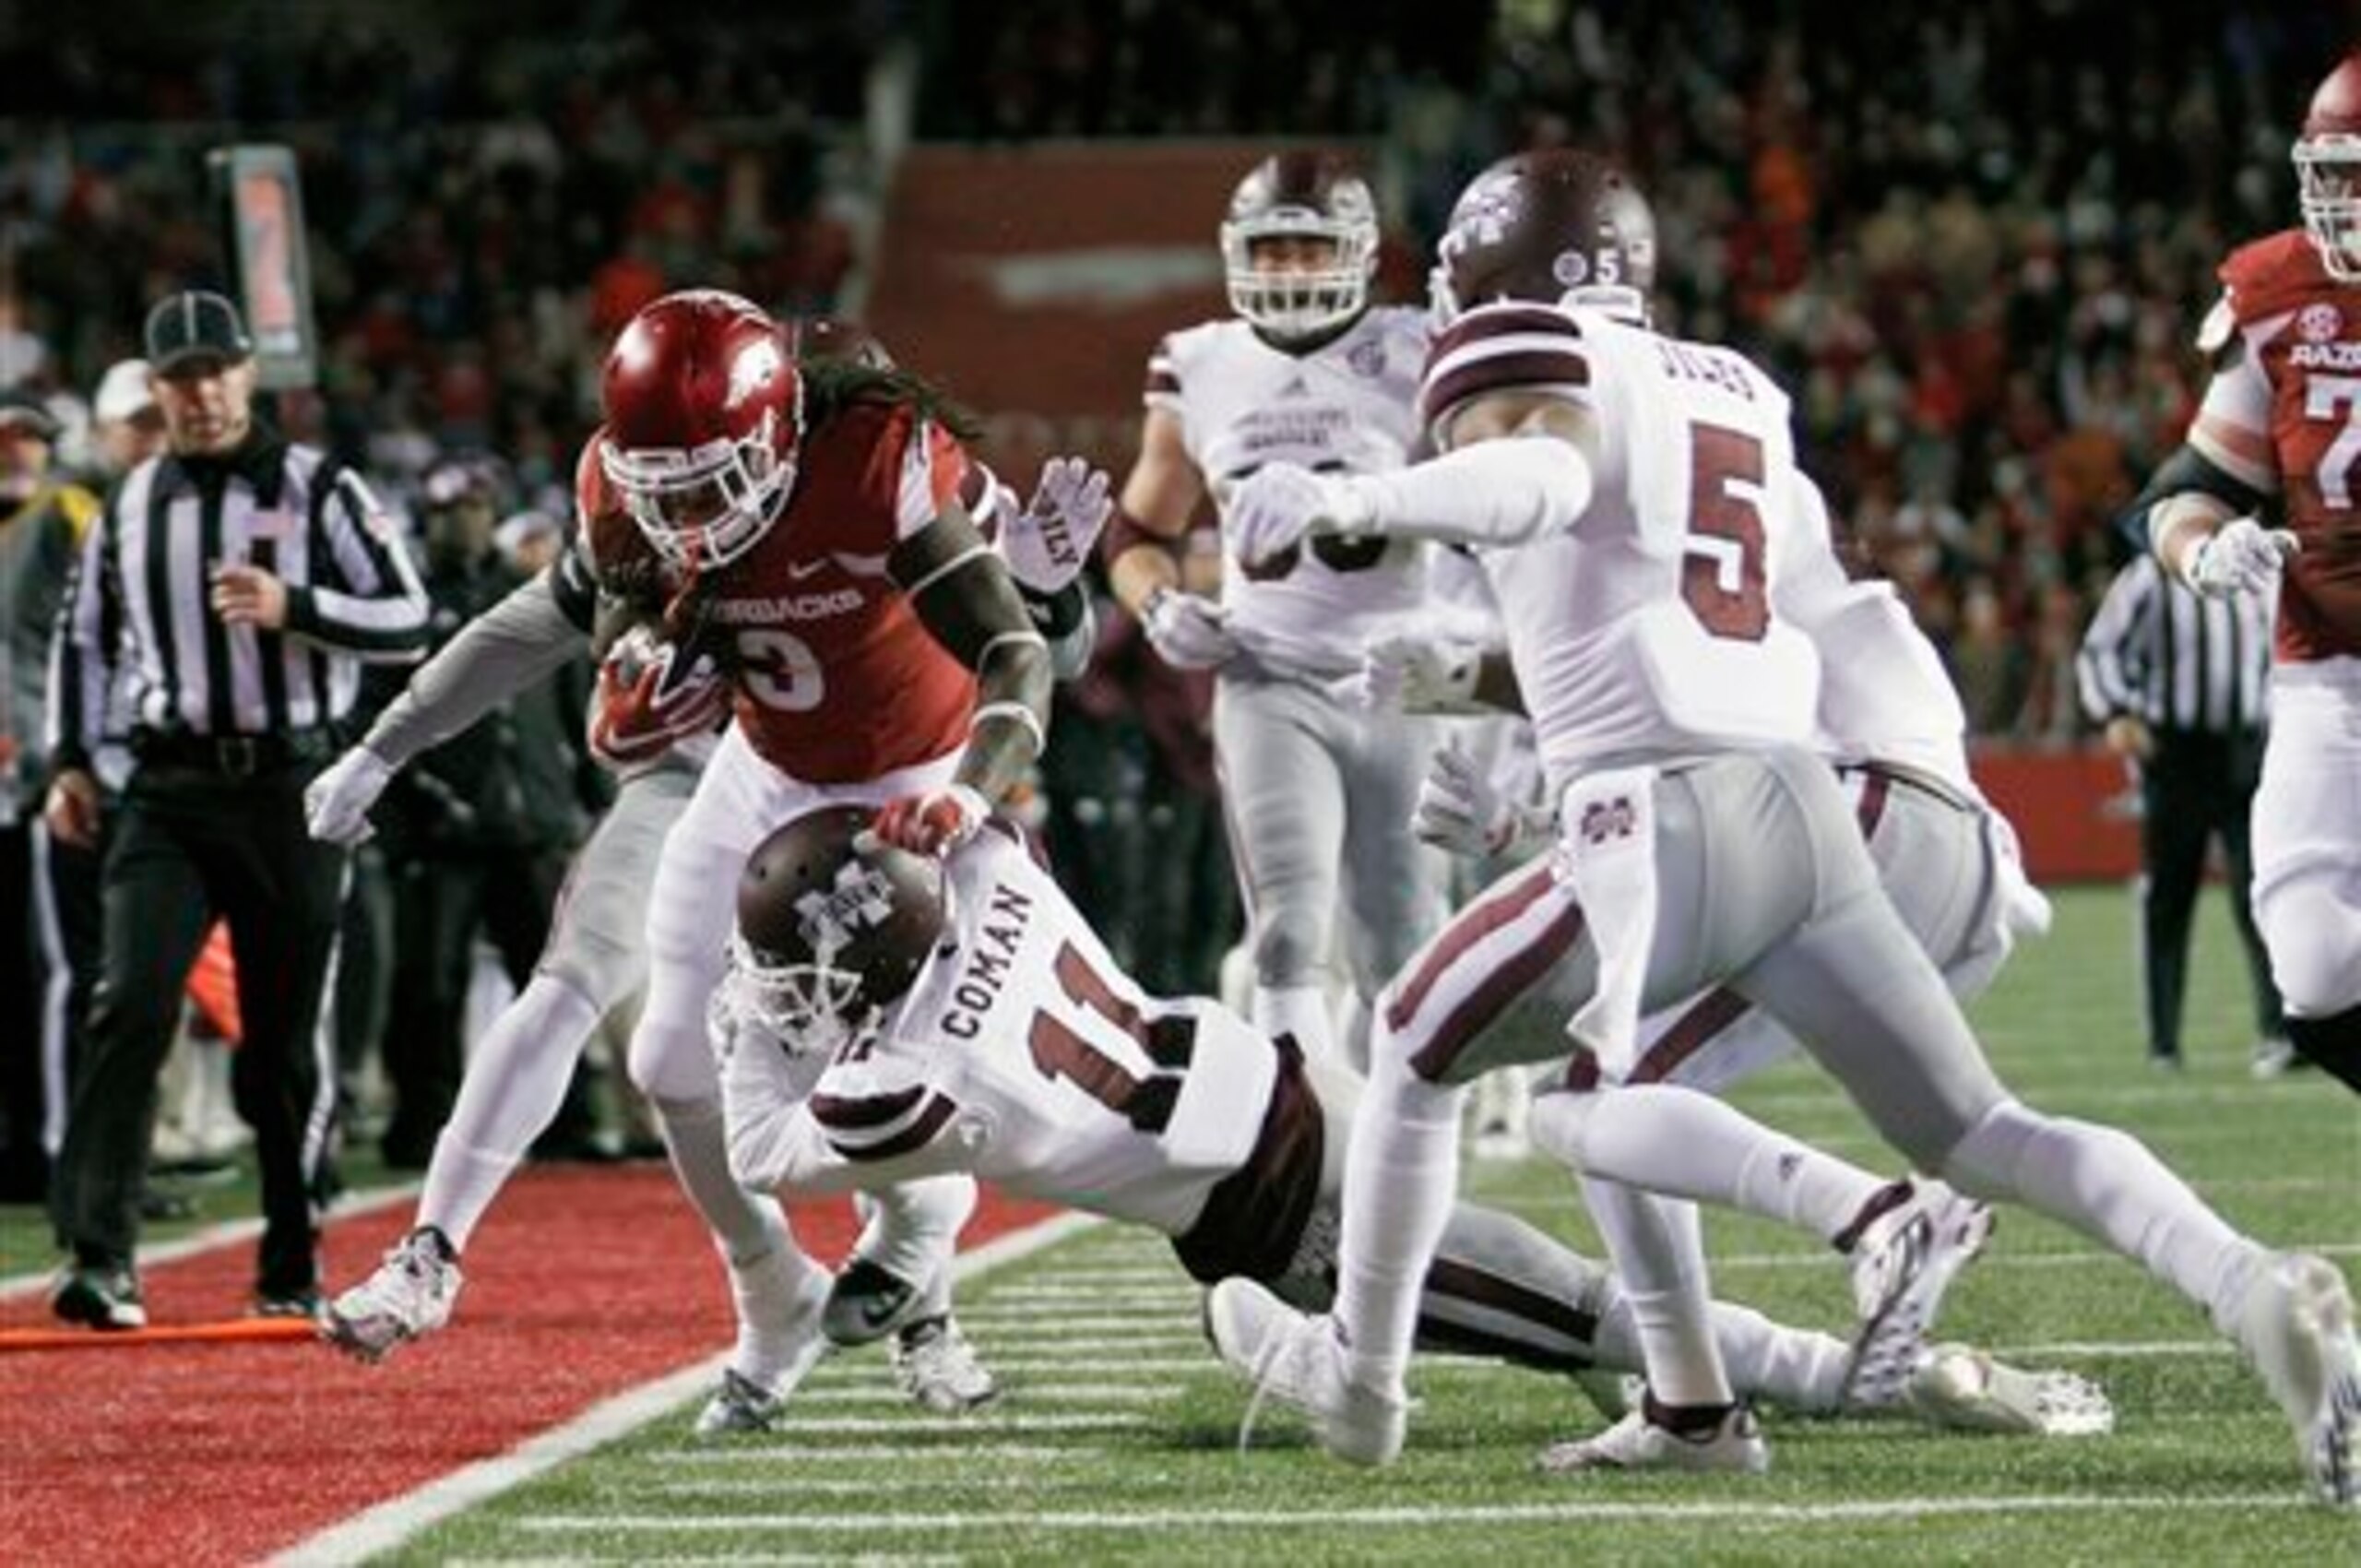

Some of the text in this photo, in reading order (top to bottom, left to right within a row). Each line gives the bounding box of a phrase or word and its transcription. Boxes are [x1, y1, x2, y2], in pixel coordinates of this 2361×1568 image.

[1596, 248, 1619, 284] 5
[1679, 419, 1769, 642] 5
[737, 629, 825, 711] 3
[940, 883, 1032, 1039] COMAN
[1027, 938, 1198, 1135] 11
